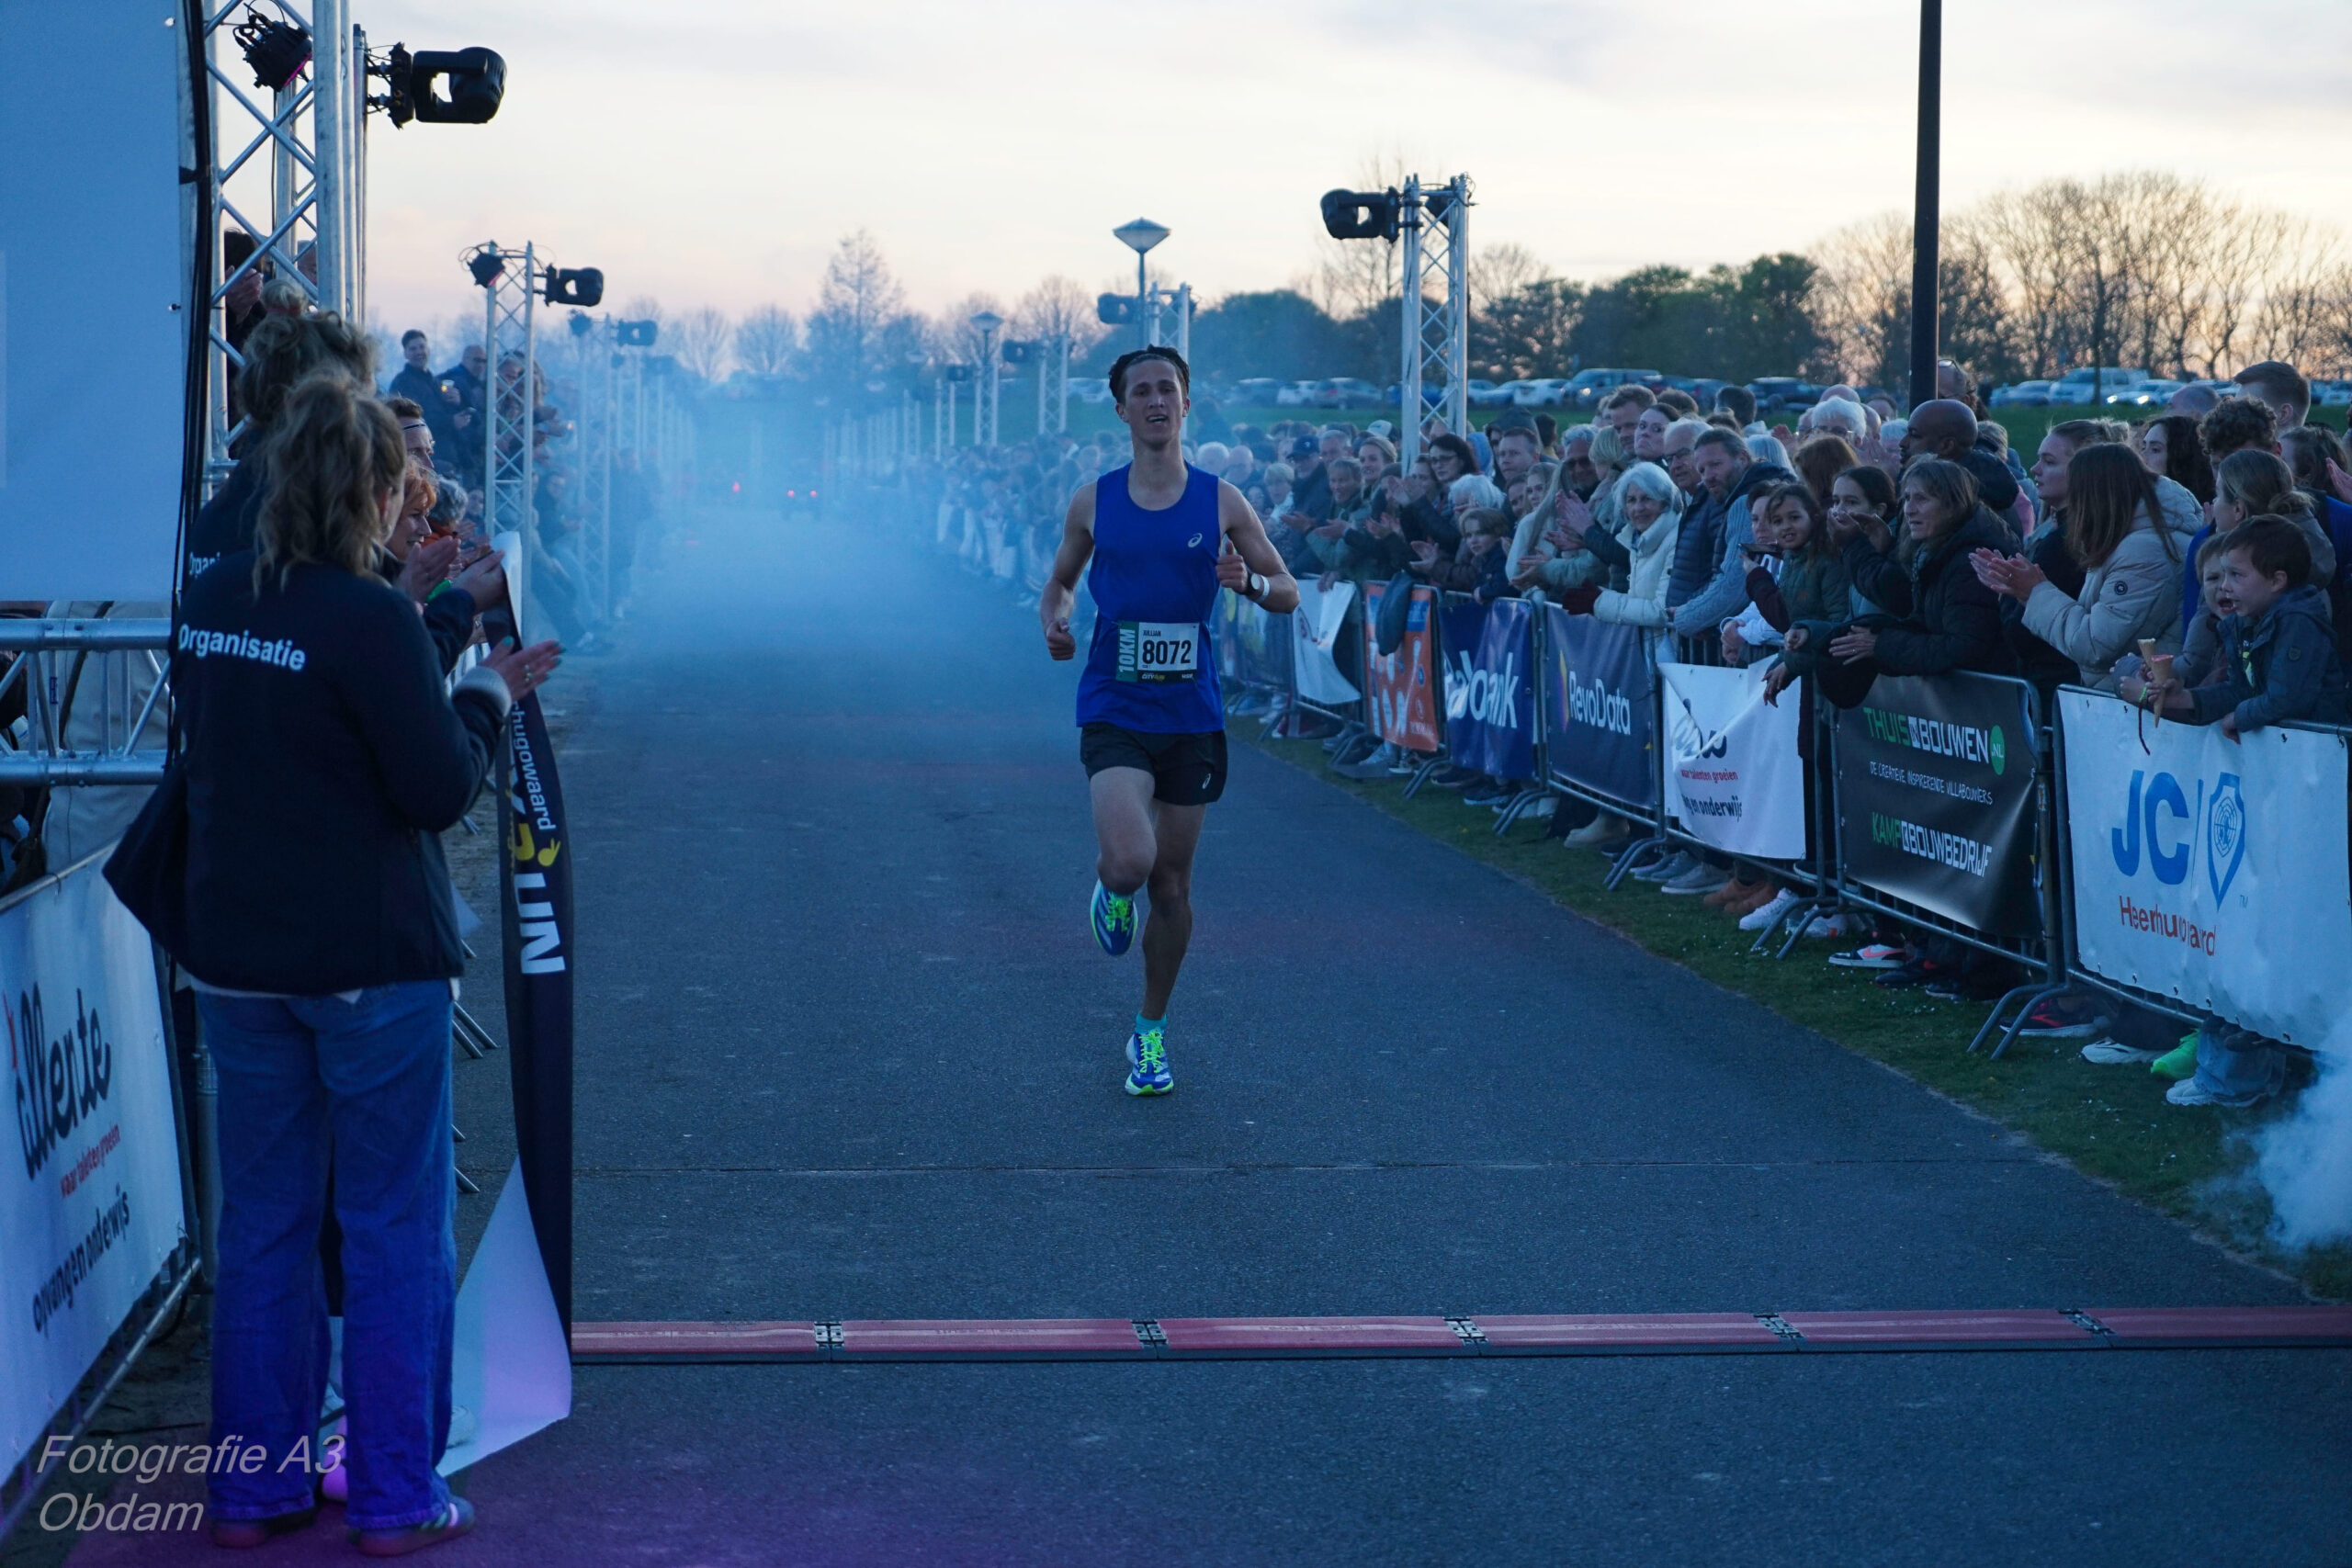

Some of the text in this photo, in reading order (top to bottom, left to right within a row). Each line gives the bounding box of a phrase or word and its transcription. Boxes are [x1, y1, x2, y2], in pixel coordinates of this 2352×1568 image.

[178, 623, 306, 671] Organisatie
[1118, 628, 1136, 672] 10KM
[1142, 639, 1192, 665] 8072
[1568, 671, 1631, 735] RevoData
[511, 700, 556, 830] rhugowaard
[1712, 768, 1739, 784] groeien
[1870, 761, 1878, 776] DE
[1699, 795, 1743, 823] onderwijs
